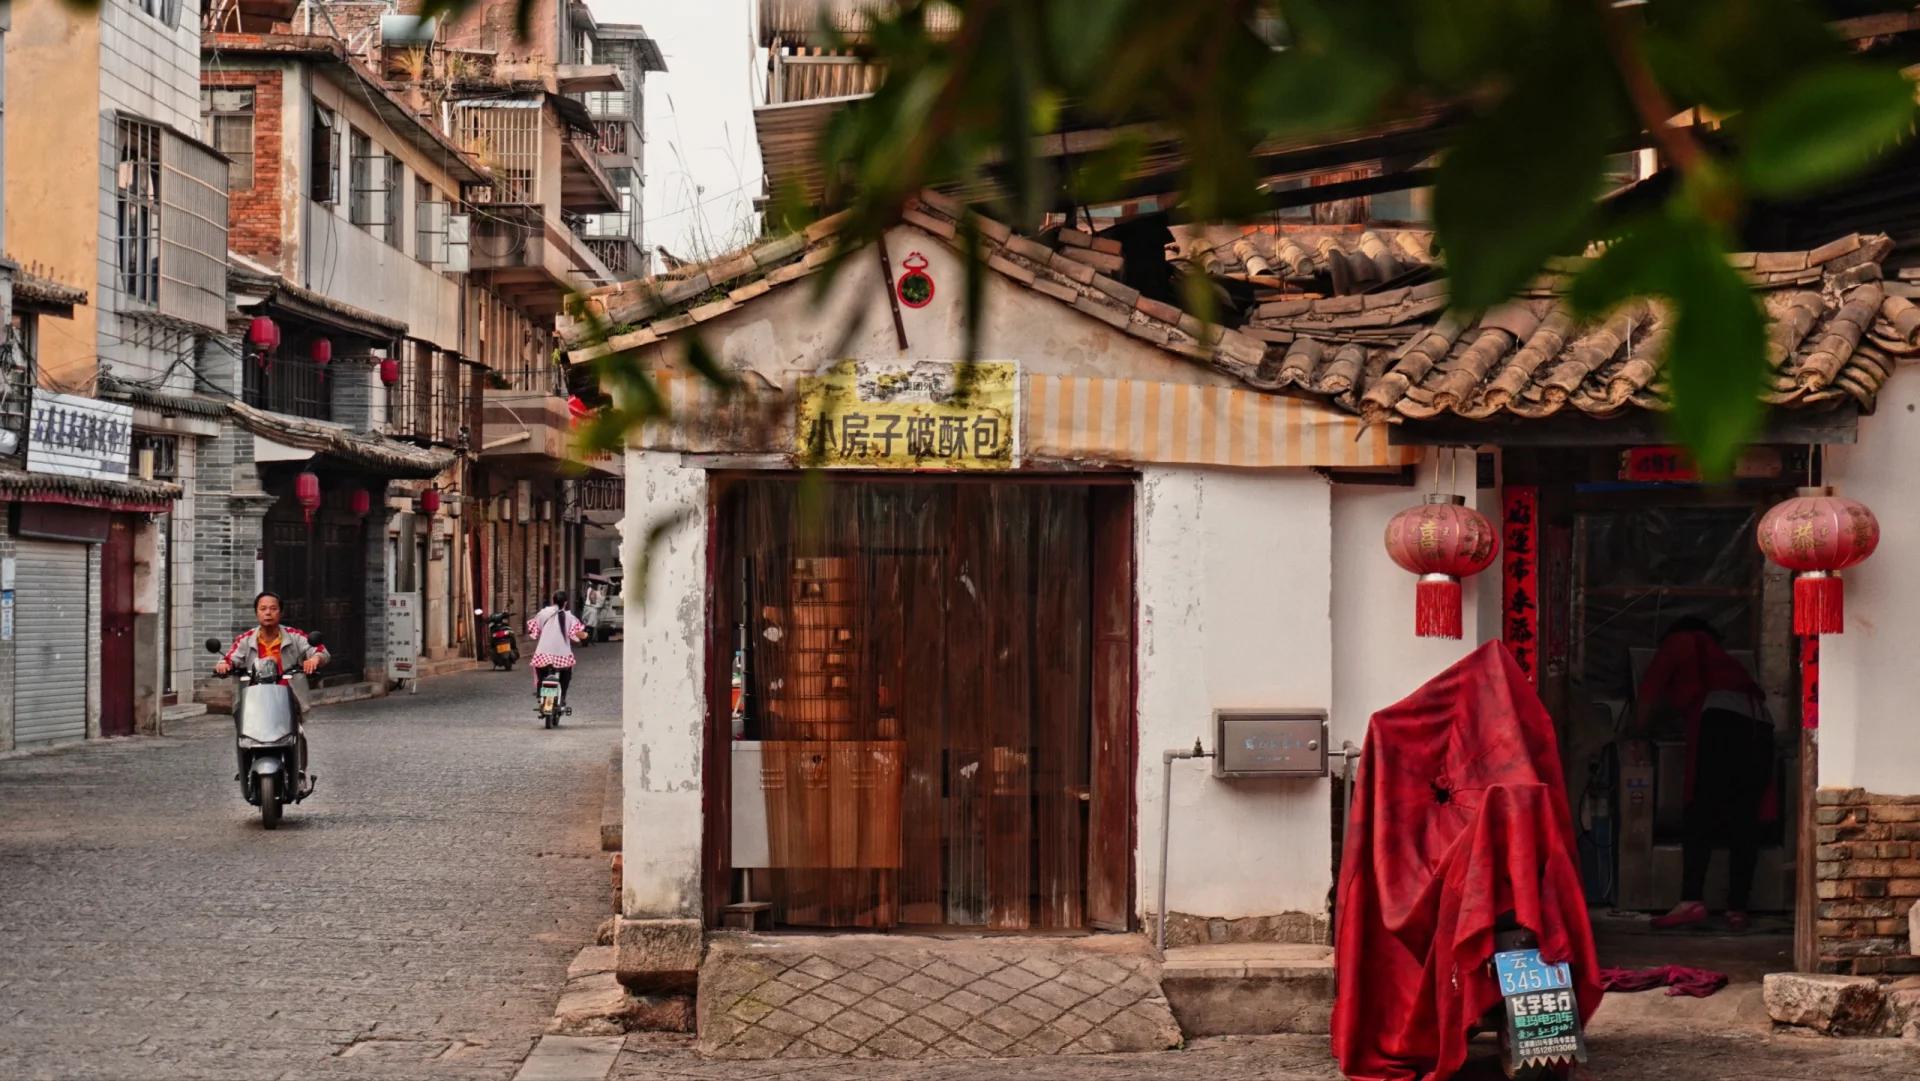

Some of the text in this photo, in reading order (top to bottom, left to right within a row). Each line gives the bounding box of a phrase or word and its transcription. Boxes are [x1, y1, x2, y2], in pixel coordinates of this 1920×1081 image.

[807, 412, 1000, 460] 小房子破酥包
[1503, 966, 1568, 993] 34510
